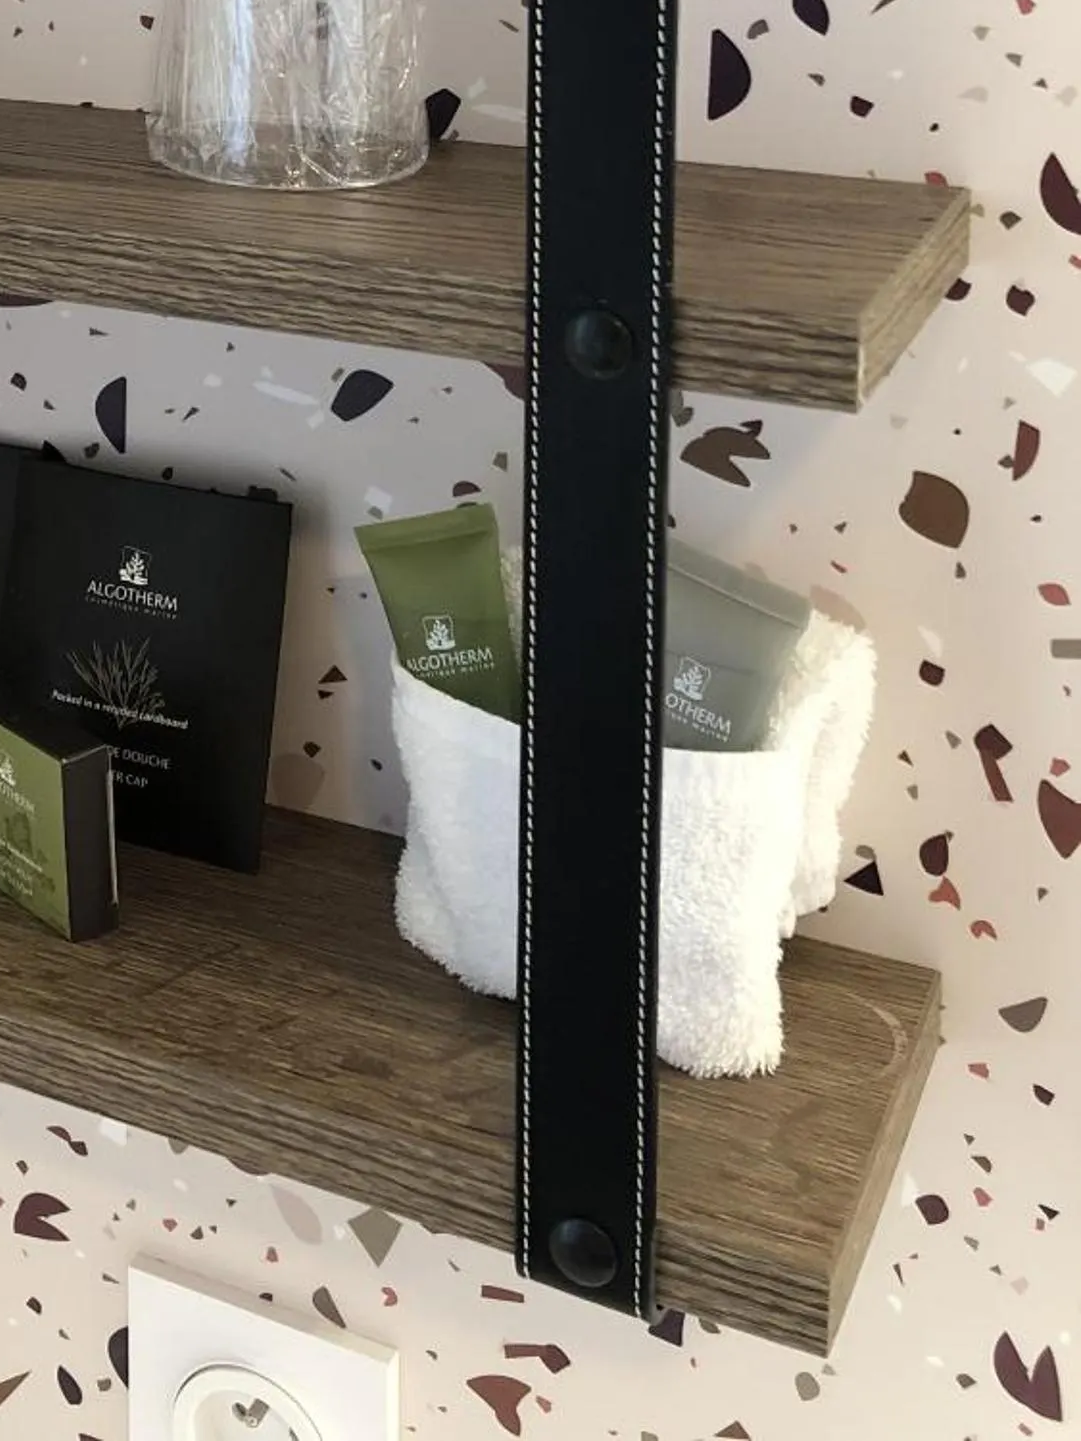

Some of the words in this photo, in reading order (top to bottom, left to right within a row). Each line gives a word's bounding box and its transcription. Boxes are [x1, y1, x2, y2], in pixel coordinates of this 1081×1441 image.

[87, 579, 178, 611] ALGOTHERM
[404, 646, 493, 672] ALGOTHERM
[52, 689, 83, 706] Packed
[665, 692, 731, 735] OTHERM
[122, 748, 170, 770] DOUCHE
[125, 773, 148, 788] CAP
